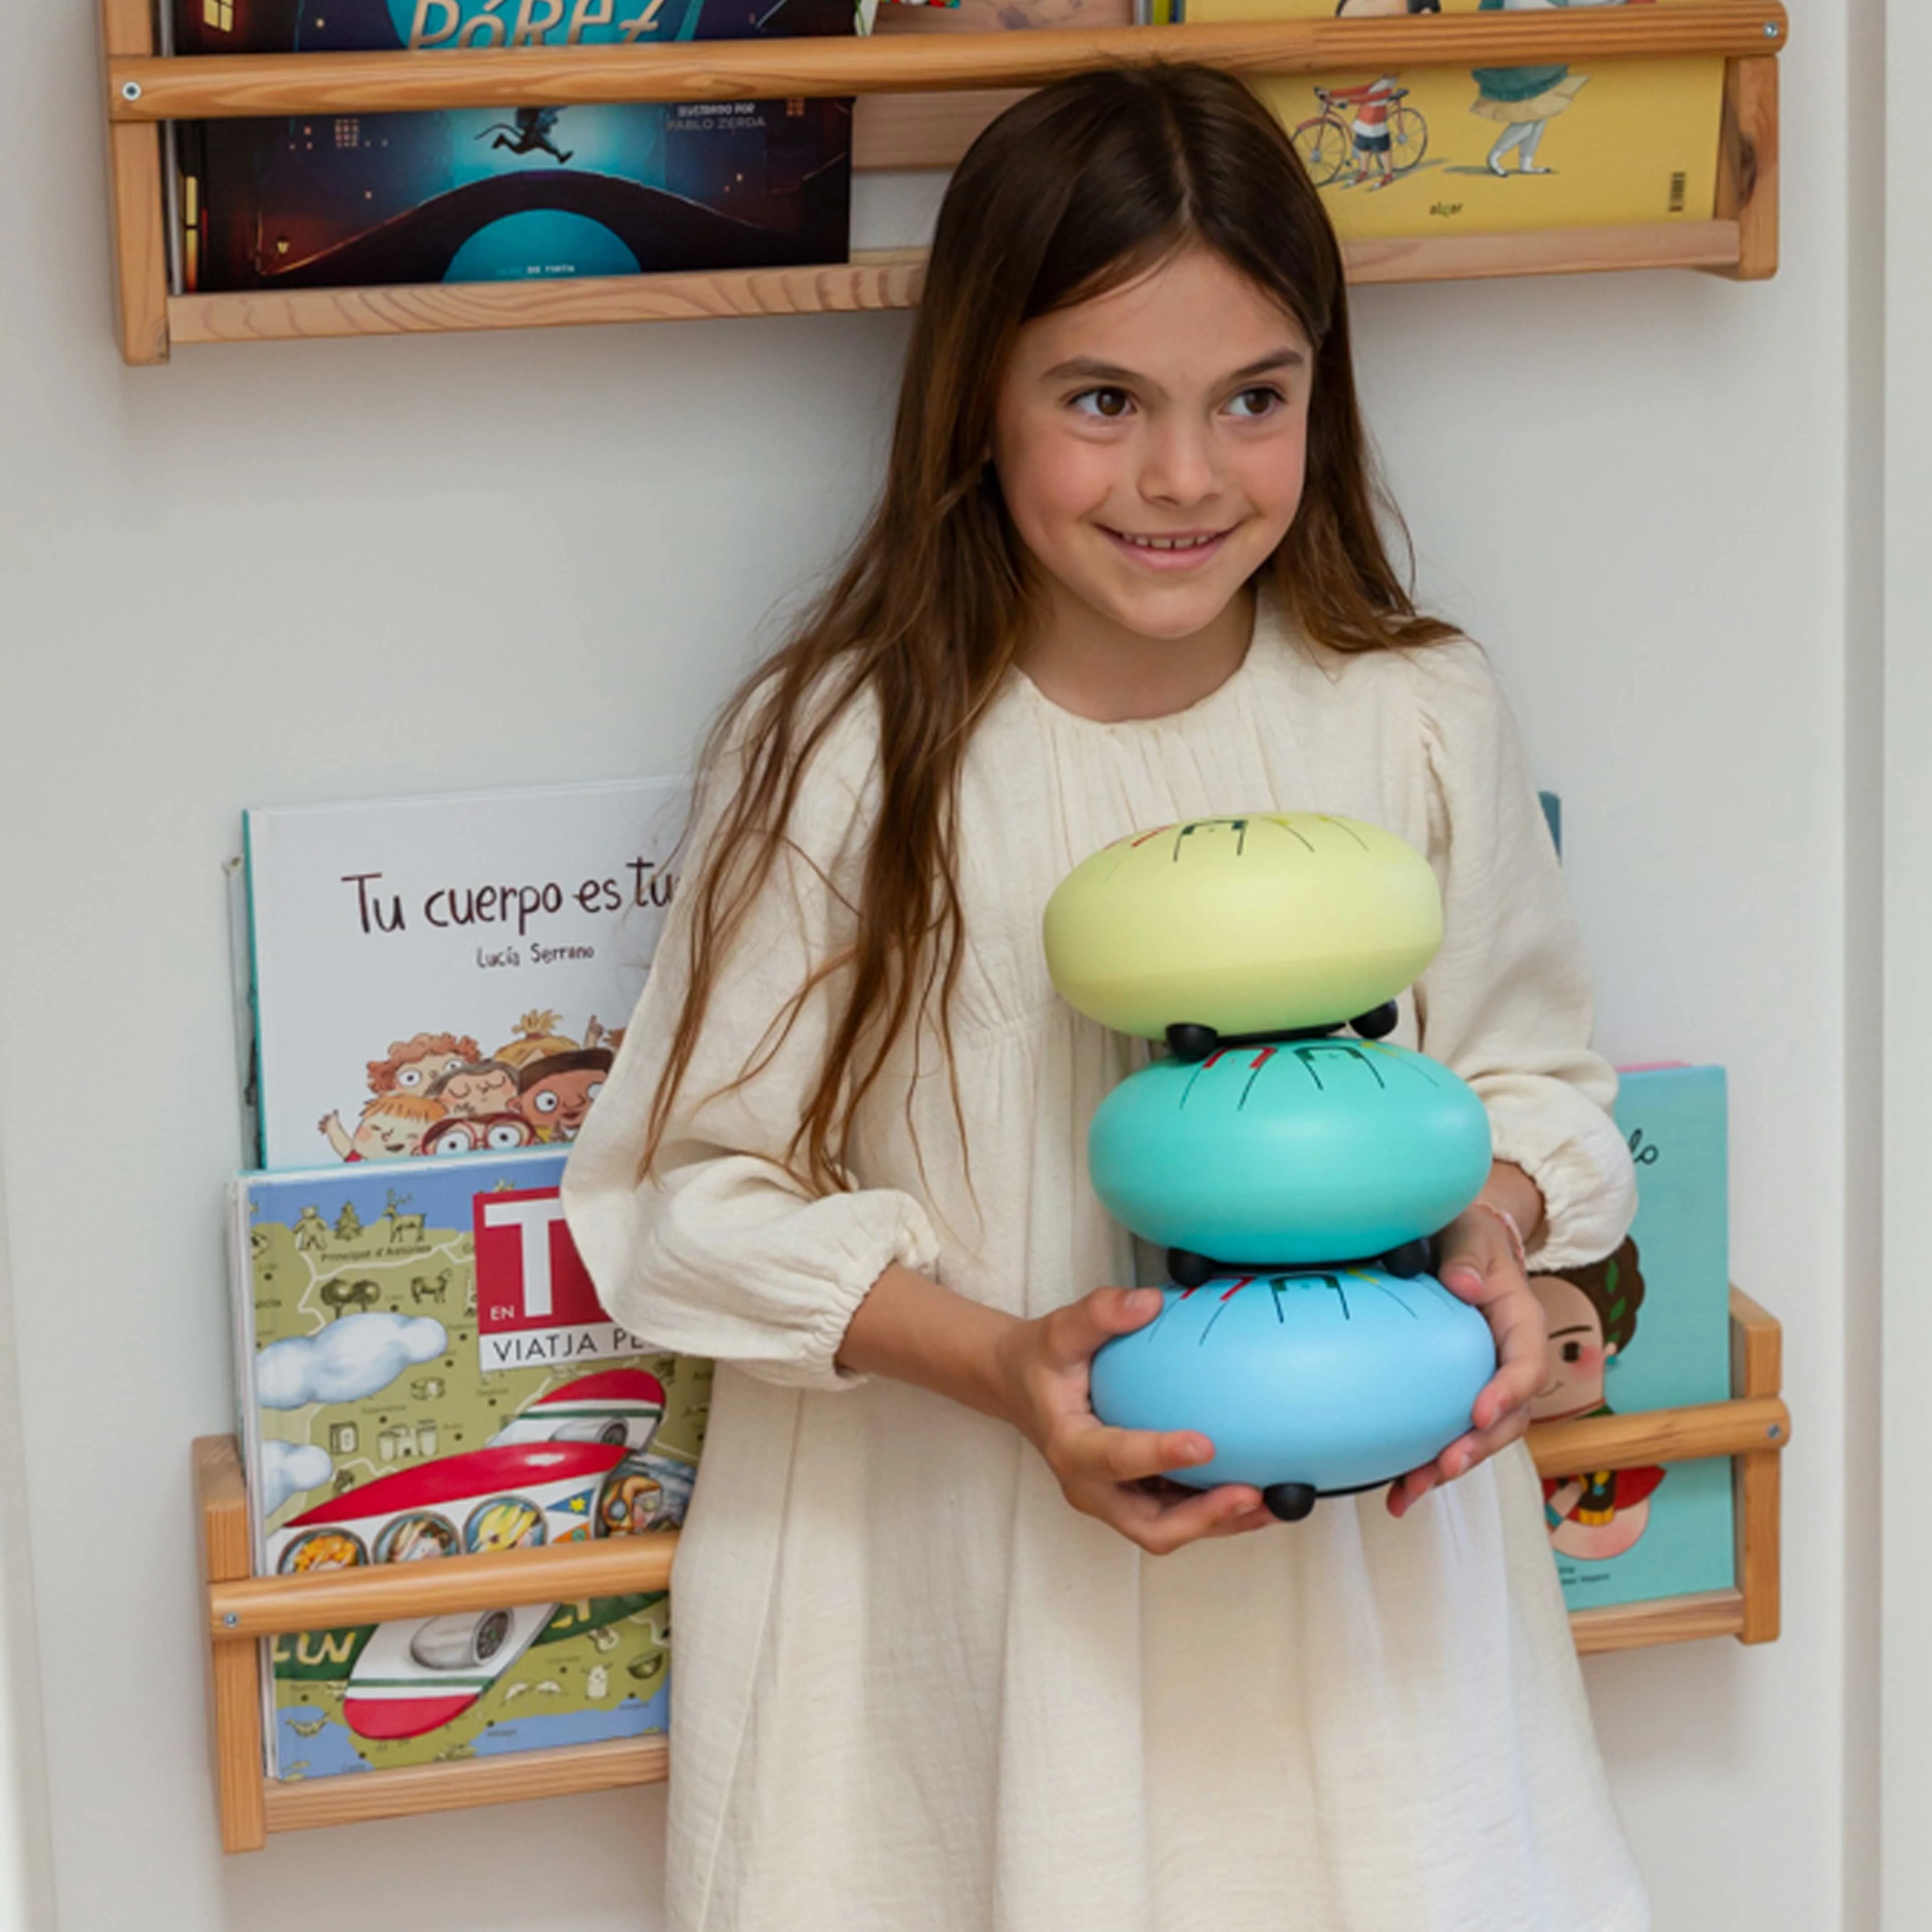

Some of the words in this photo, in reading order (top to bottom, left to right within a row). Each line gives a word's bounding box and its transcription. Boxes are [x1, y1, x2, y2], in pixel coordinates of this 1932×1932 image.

[734, 102, 755, 114] POR
[667, 118, 714, 131] PABLO
[717, 115, 766, 129] ZERDA
[341, 872, 405, 934] Tu
[424, 882, 563, 936] cuerpo
[577, 878, 622, 913] es
[625, 856, 680, 908] tu
[476, 945, 520, 969] Lucía
[530, 941, 595, 965] Serrano
[1627, 1128, 1660, 1166] lo
[490, 1305, 515, 1321] EN
[493, 1332, 598, 1362] VIATJA
